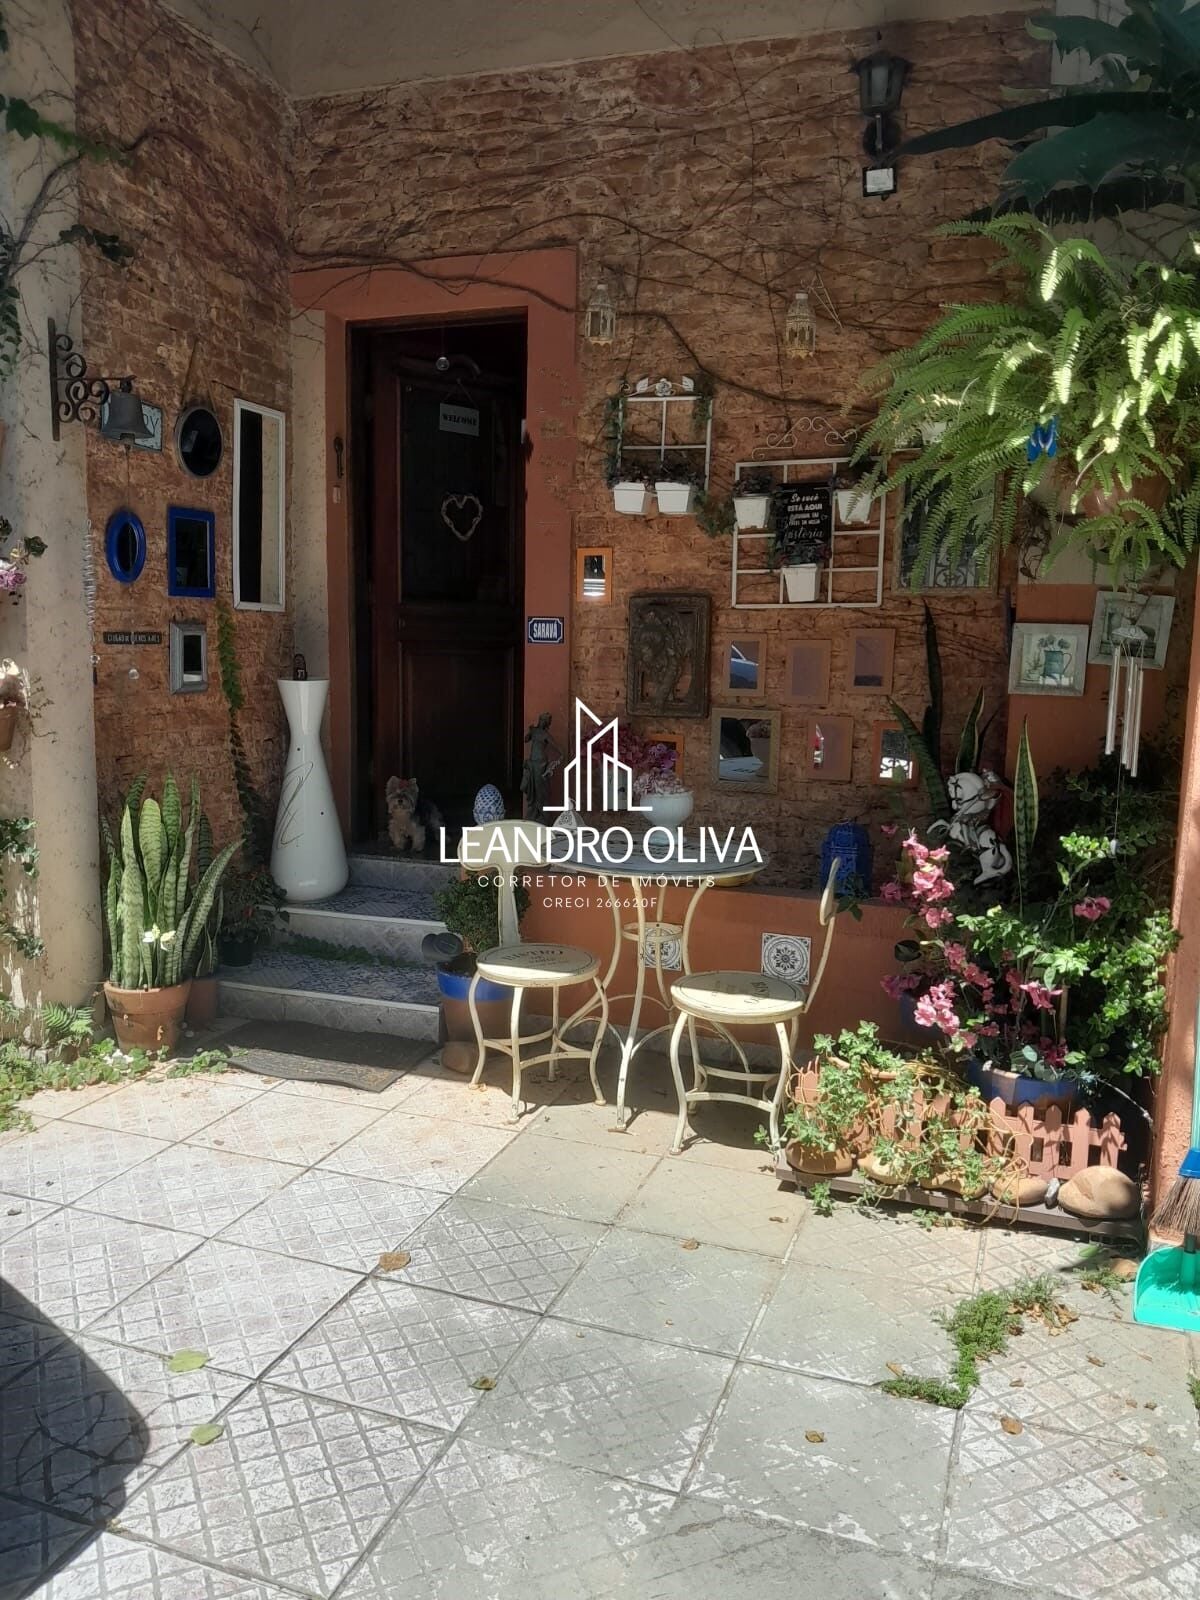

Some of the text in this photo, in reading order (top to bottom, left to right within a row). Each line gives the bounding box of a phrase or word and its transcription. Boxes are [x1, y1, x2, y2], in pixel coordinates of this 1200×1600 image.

[442, 413, 477, 426] WELCOME
[804, 503, 823, 511] AQUI
[533, 620, 558, 639] SARAVÁ
